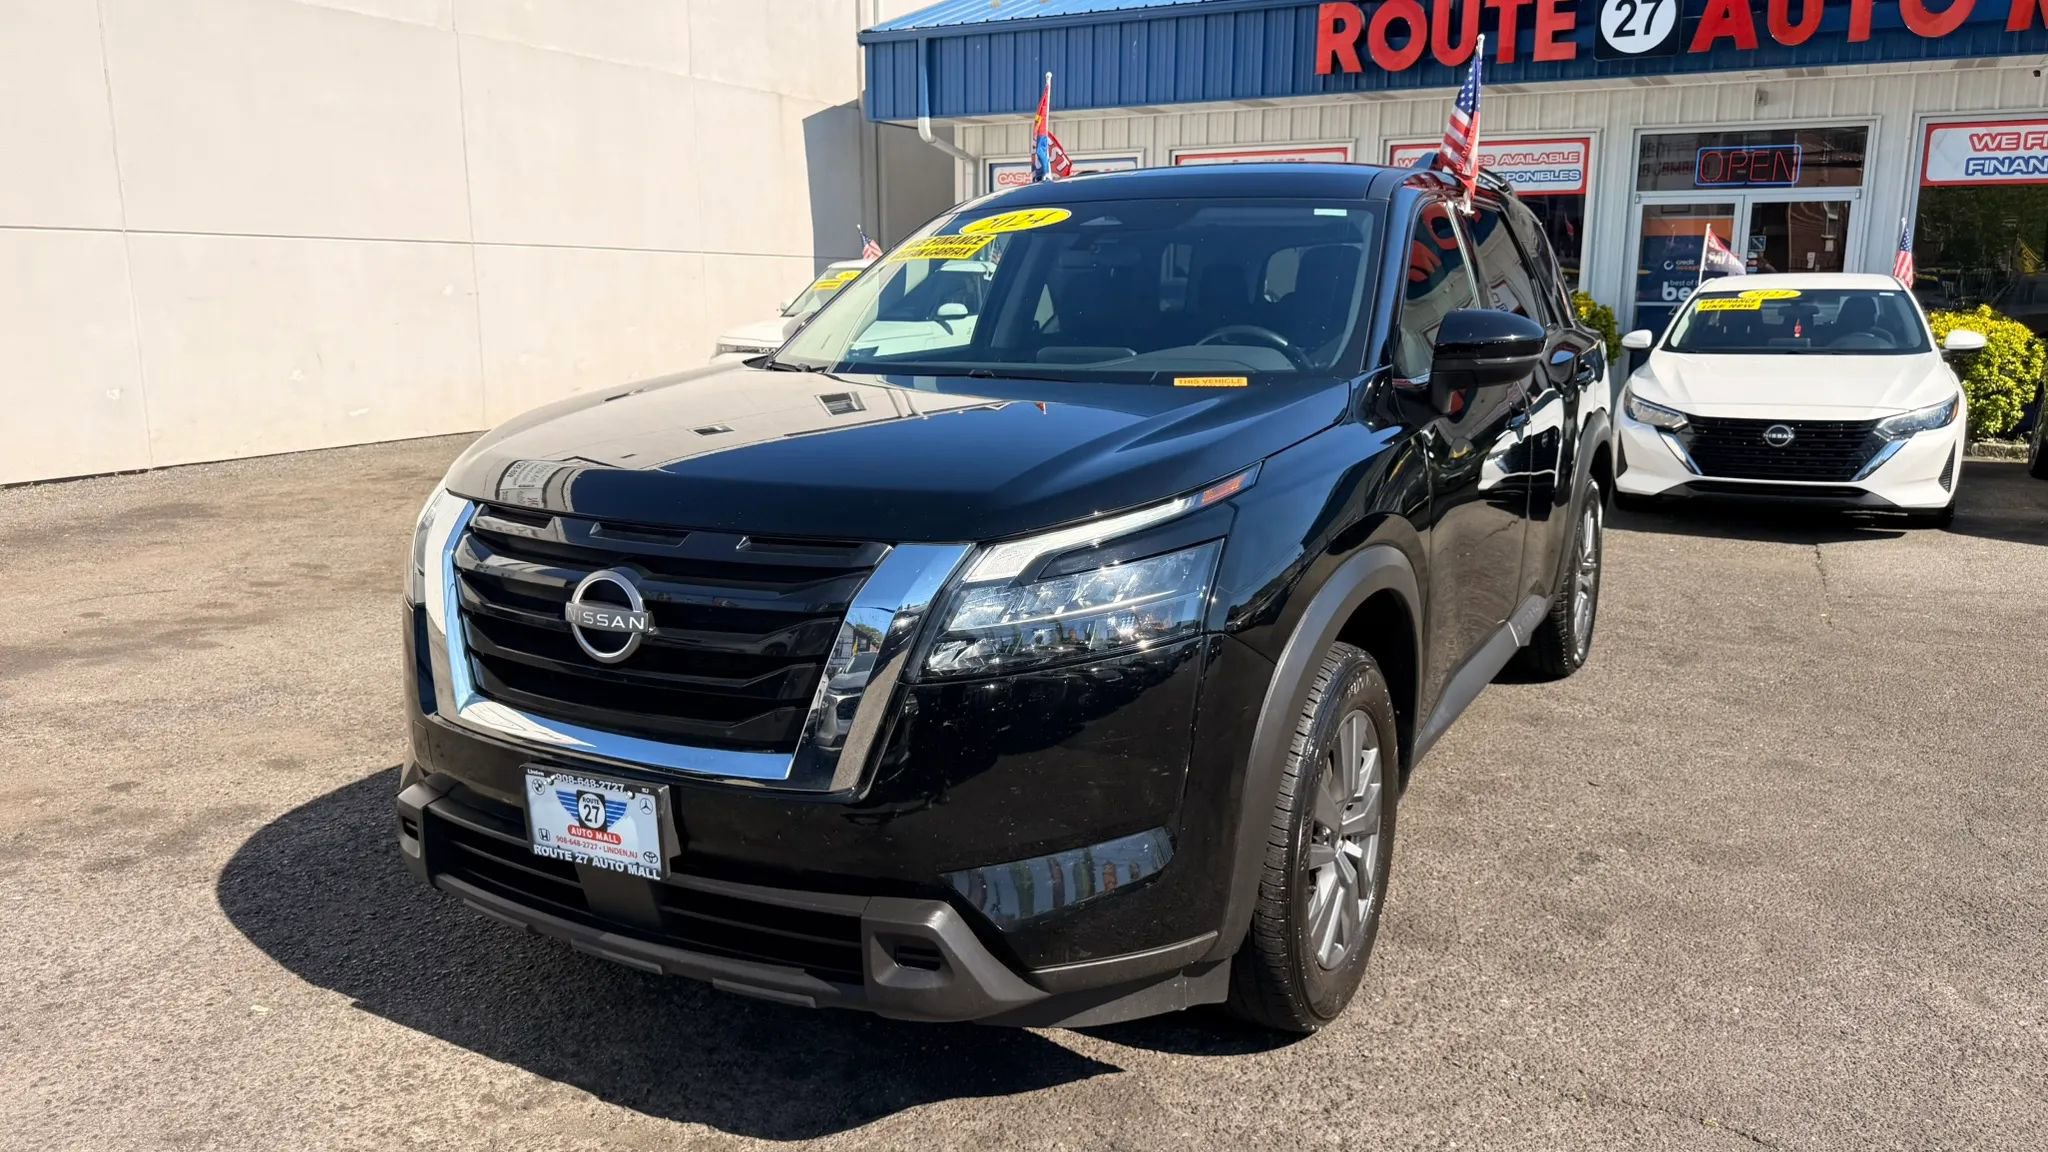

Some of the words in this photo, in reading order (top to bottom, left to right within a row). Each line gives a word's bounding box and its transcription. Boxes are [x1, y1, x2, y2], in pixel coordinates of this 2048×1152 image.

[1315, 0, 1577, 75] ROUTE
[1612, 0, 1659, 38] 27
[1968, 132, 2021, 152] WE
[1499, 151, 1580, 166] AVAILABLE
[1701, 151, 1794, 182] OPEN
[971, 211, 1058, 232] 2024
[924, 235, 990, 248] FINANCE
[924, 247, 972, 257] CARFAX
[1203, 377, 1243, 385] VEHICLE
[567, 606, 645, 630] NISSAN
[555, 773, 625, 792] 908-648-2727
[582, 797, 600, 805] ROUTE
[583, 803, 600, 823] 27
[570, 827, 594, 839] AUTO
[595, 832, 619, 844] MALL
[533, 844, 573, 862] ROUTE
[575, 853, 589, 864] 27
[592, 855, 625, 873] AUTO
[627, 863, 661, 881] MALL
